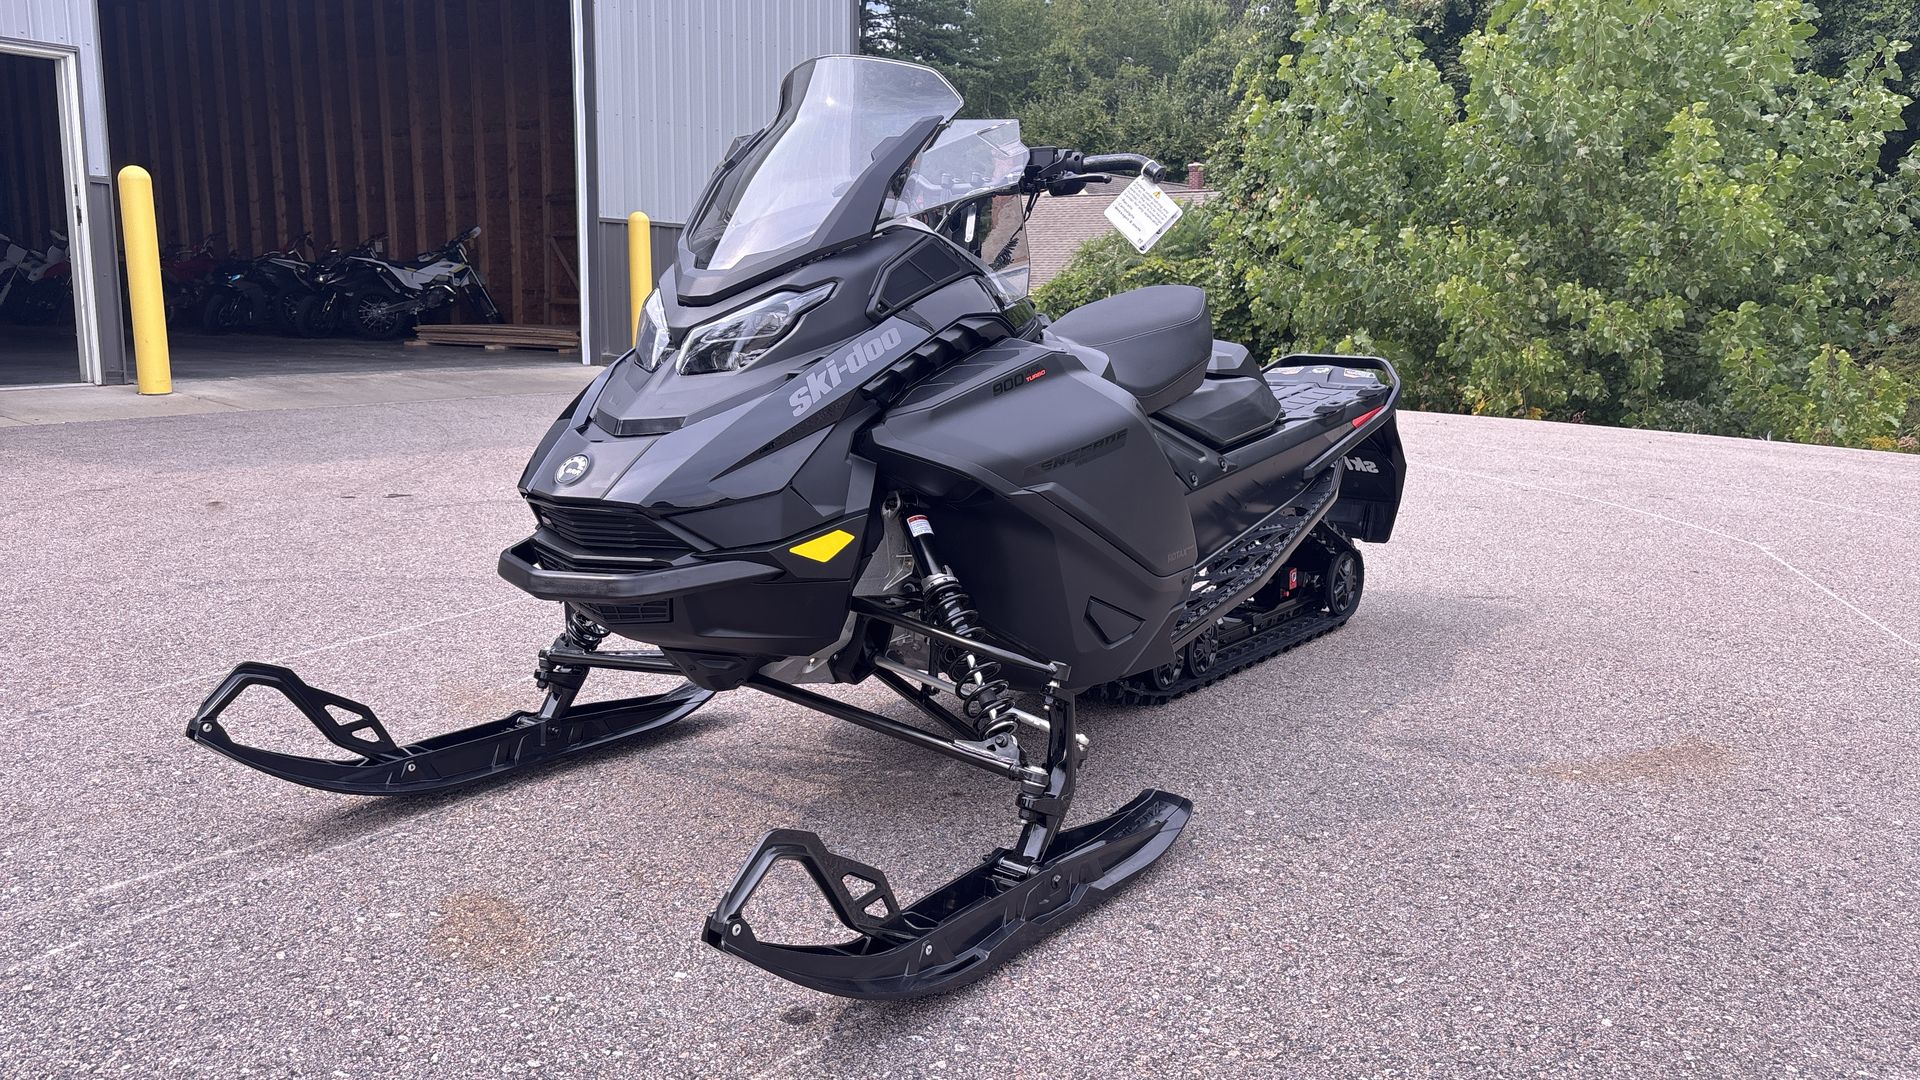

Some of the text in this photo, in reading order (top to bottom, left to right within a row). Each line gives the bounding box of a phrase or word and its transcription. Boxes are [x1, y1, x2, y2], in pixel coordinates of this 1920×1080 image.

[789, 327, 901, 417] ski-doo
[993, 369, 1046, 397] 900 TURBO
